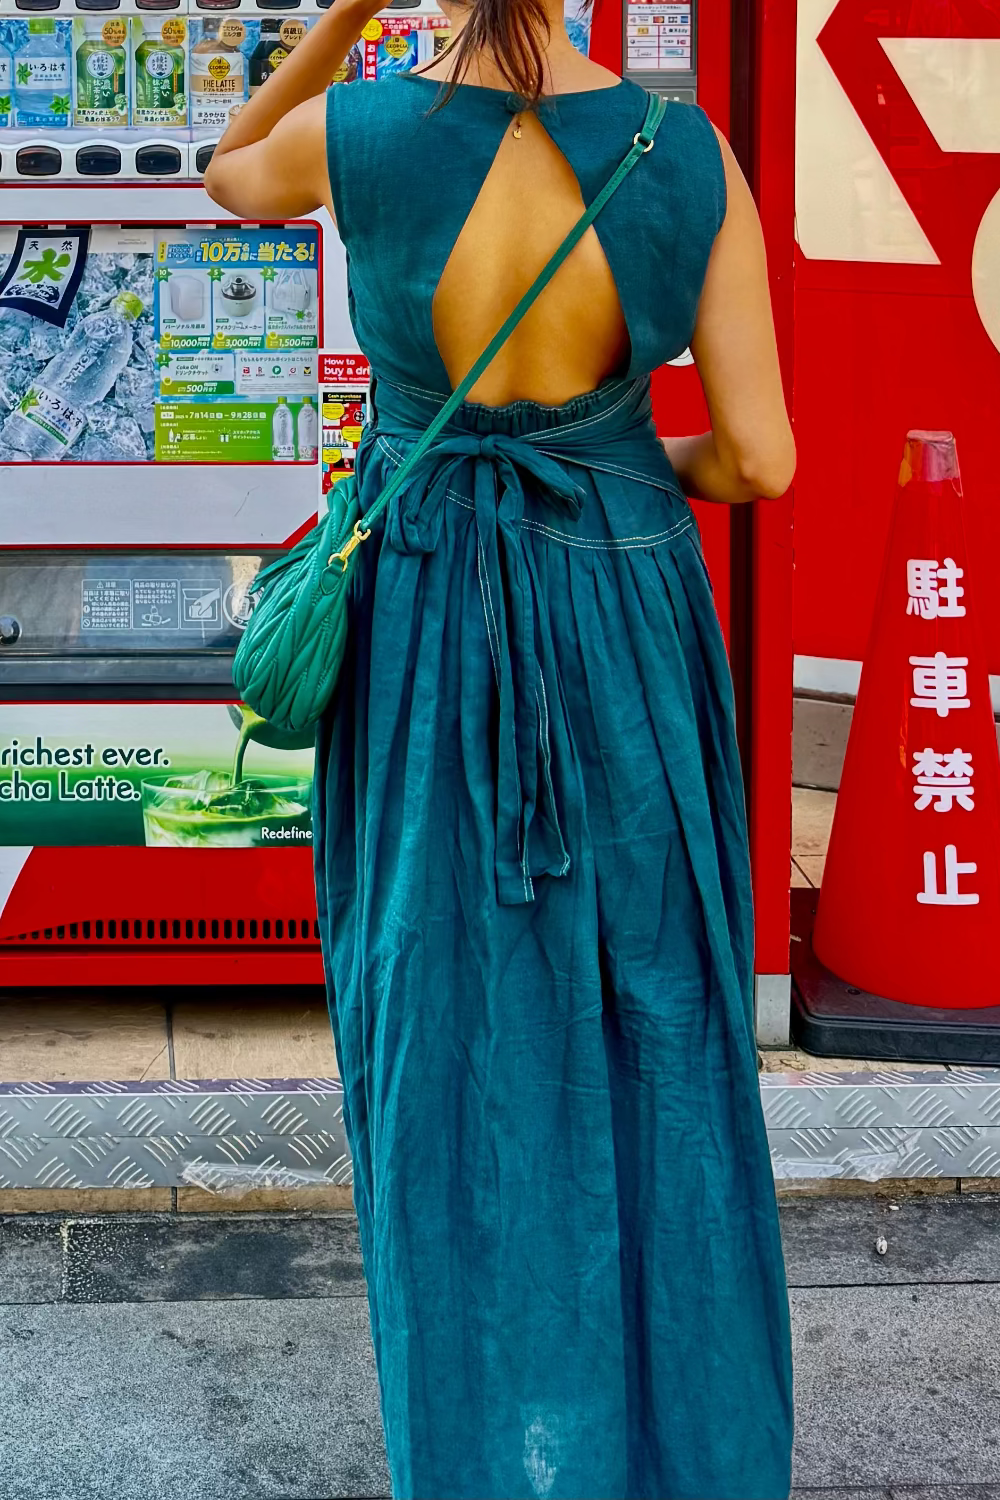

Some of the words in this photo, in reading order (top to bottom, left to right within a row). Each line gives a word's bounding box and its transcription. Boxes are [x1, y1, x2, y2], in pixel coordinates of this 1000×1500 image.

[203, 79, 214, 88] THE
[215, 79, 236, 88] LATTE
[324, 357, 345, 365] How
[324, 366, 344, 377] buy
[905, 558, 980, 906] 駐車禁止
[1, 736, 94, 767] richest
[101, 747, 170, 767] ever.
[59, 770, 141, 801] Latte.
[261, 826, 313, 840] Redefine
